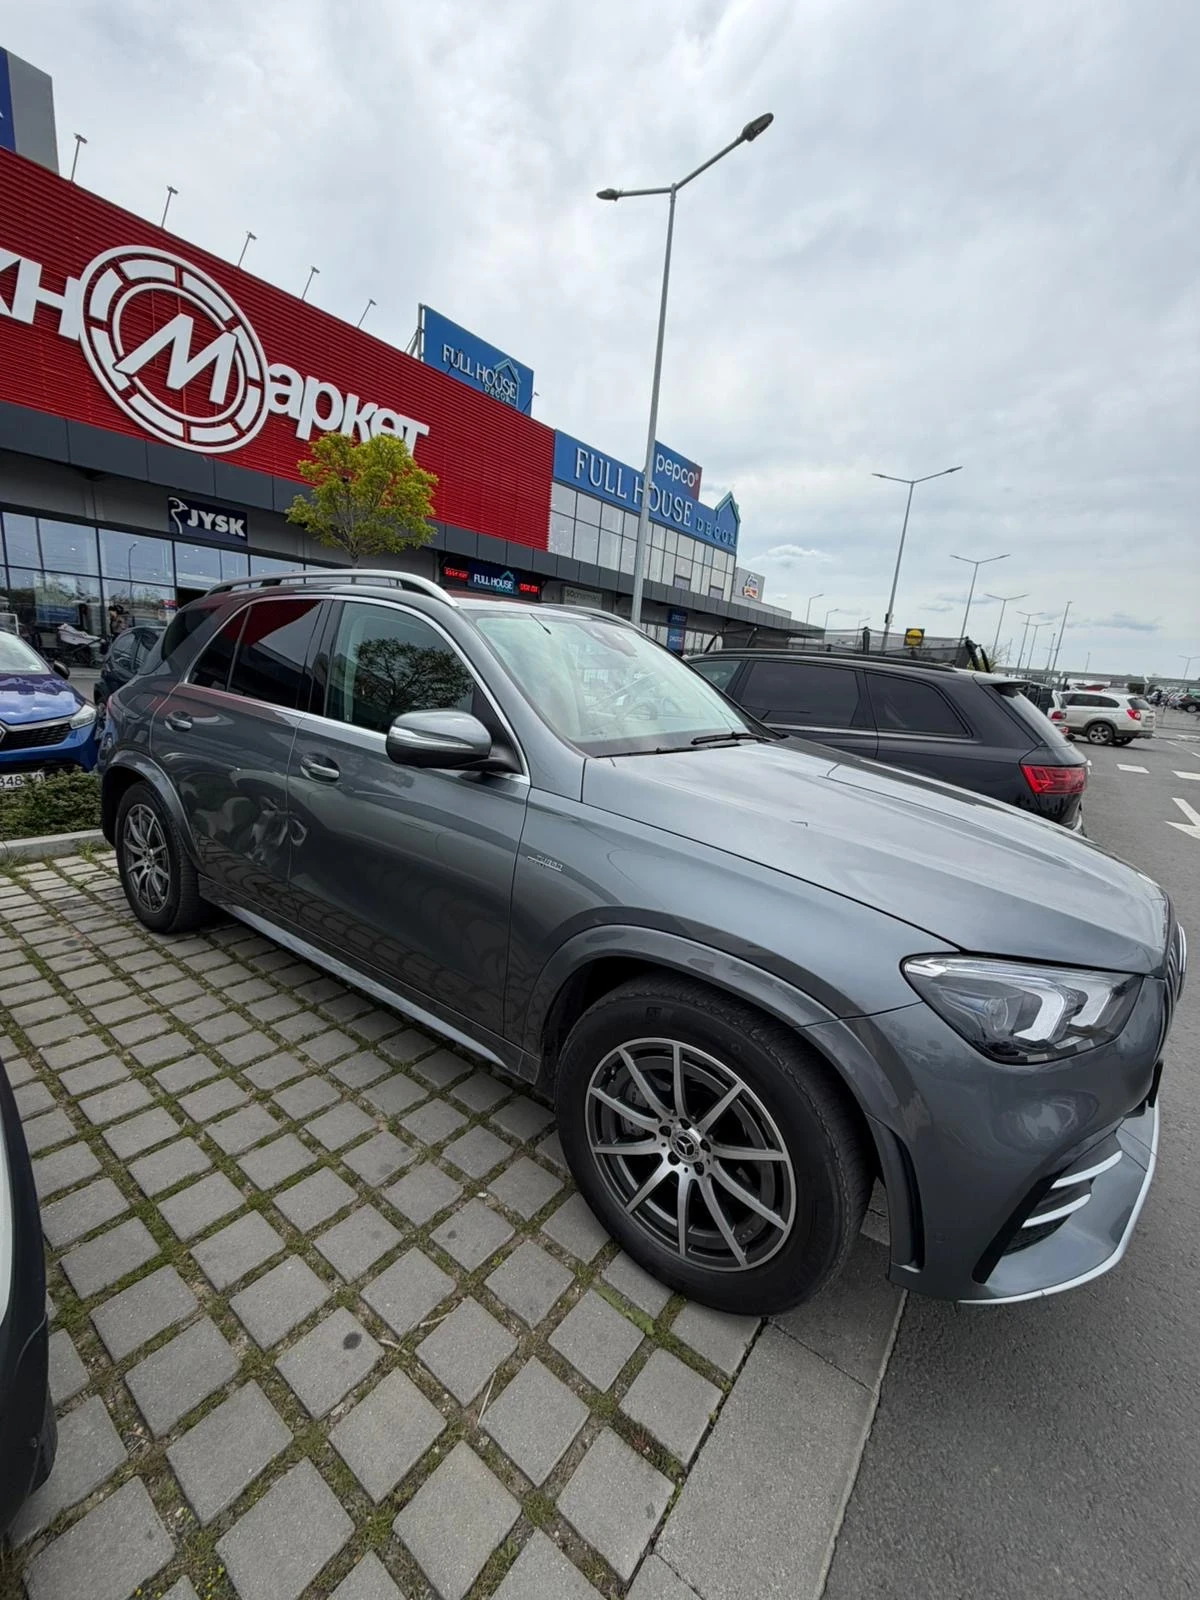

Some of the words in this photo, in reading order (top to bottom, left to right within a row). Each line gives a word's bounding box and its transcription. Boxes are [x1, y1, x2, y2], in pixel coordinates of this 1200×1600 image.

[443, 343, 474, 377] FULL
[476, 361, 517, 399] HOUSE
[575, 447, 627, 500] FULL
[655, 453, 696, 488] pepco
[187, 508, 246, 537] JYSK
[473, 573, 490, 586] FULL
[490, 576, 513, 590] HOUSE
